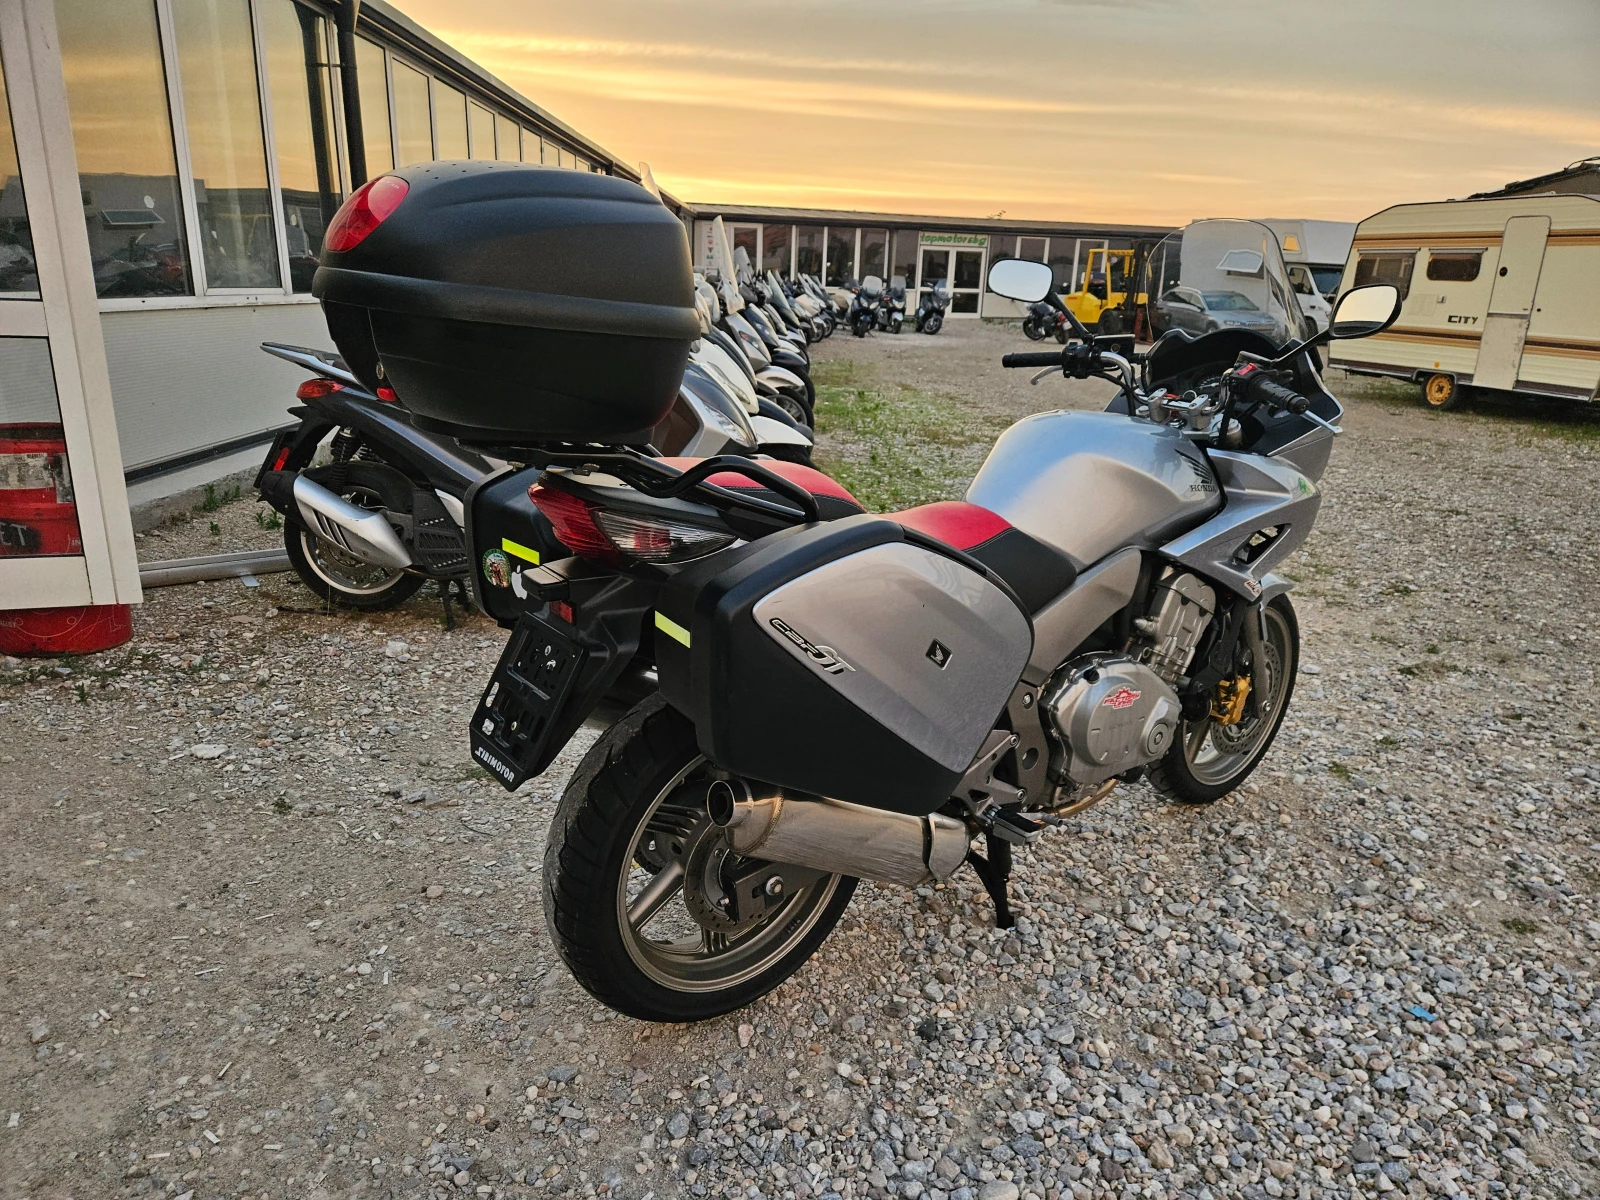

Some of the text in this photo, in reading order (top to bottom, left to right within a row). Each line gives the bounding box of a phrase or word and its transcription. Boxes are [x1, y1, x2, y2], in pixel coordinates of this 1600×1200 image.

[1447, 315, 1478, 324] CITY
[1190, 484, 1217, 493] HONDA
[474, 746, 515, 783] SIBIMOTOR
